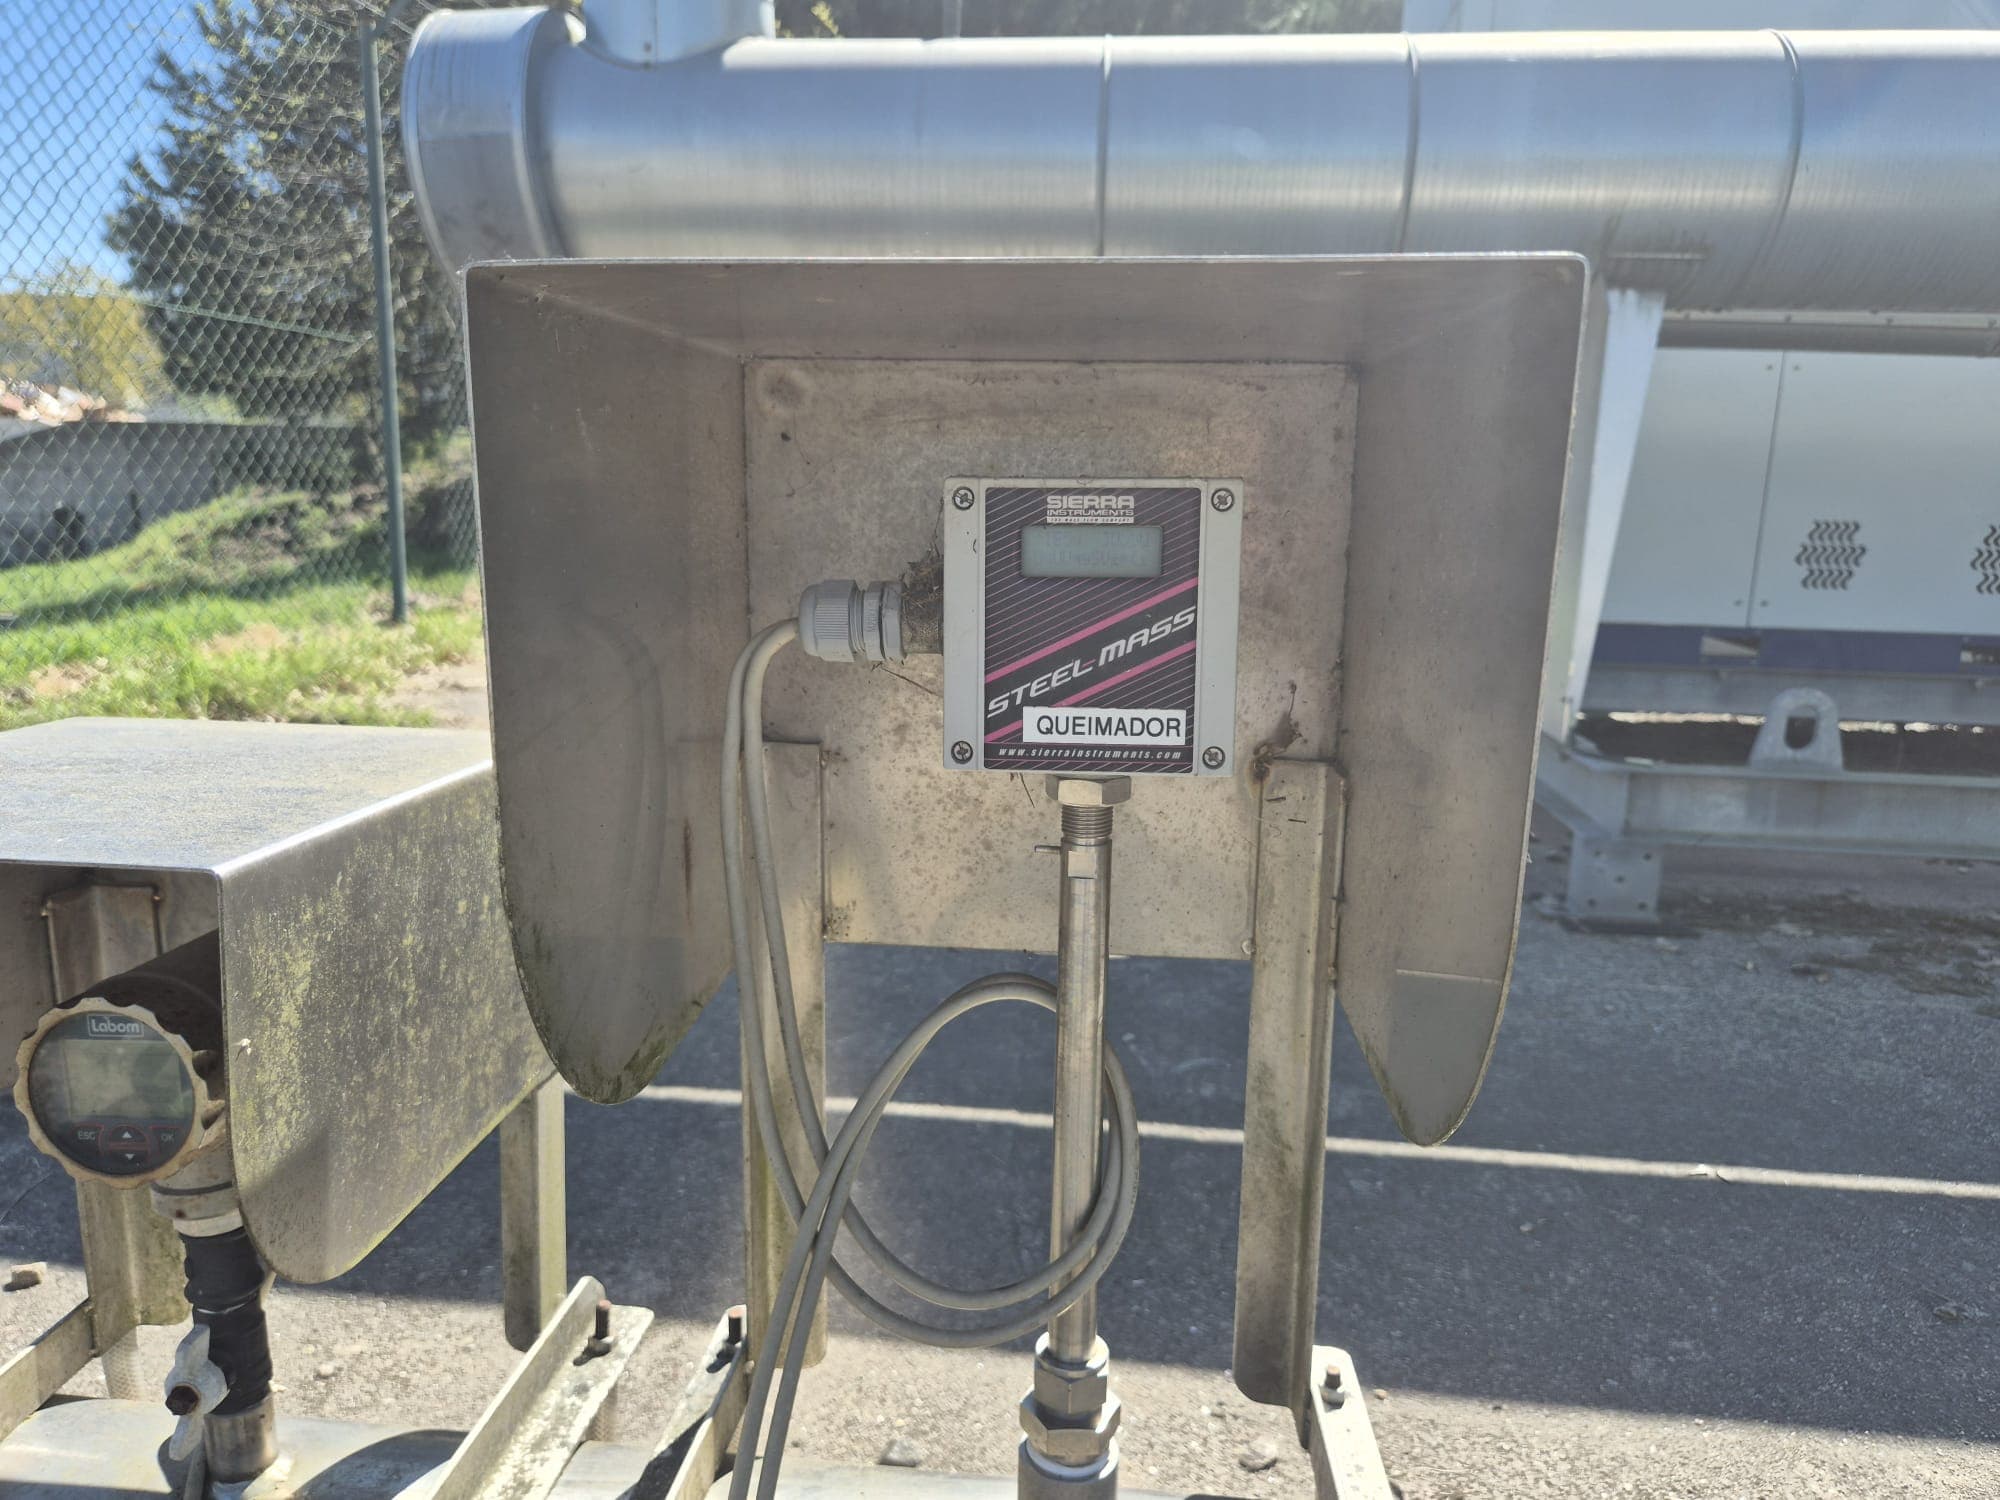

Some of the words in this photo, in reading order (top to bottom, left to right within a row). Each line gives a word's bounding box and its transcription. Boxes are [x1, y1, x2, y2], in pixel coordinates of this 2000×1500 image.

[1046, 495, 1135, 509] SIERRA
[1046, 509, 1134, 517] INSTRUMENTS
[987, 658, 1093, 718] STEEL
[1098, 606, 1196, 667] MASS
[1036, 715, 1181, 738] QUEIMADOR
[998, 747, 1182, 760] www.sierrainstruments.com
[91, 1018, 141, 1034] Labom
[160, 1132, 176, 1142] OK
